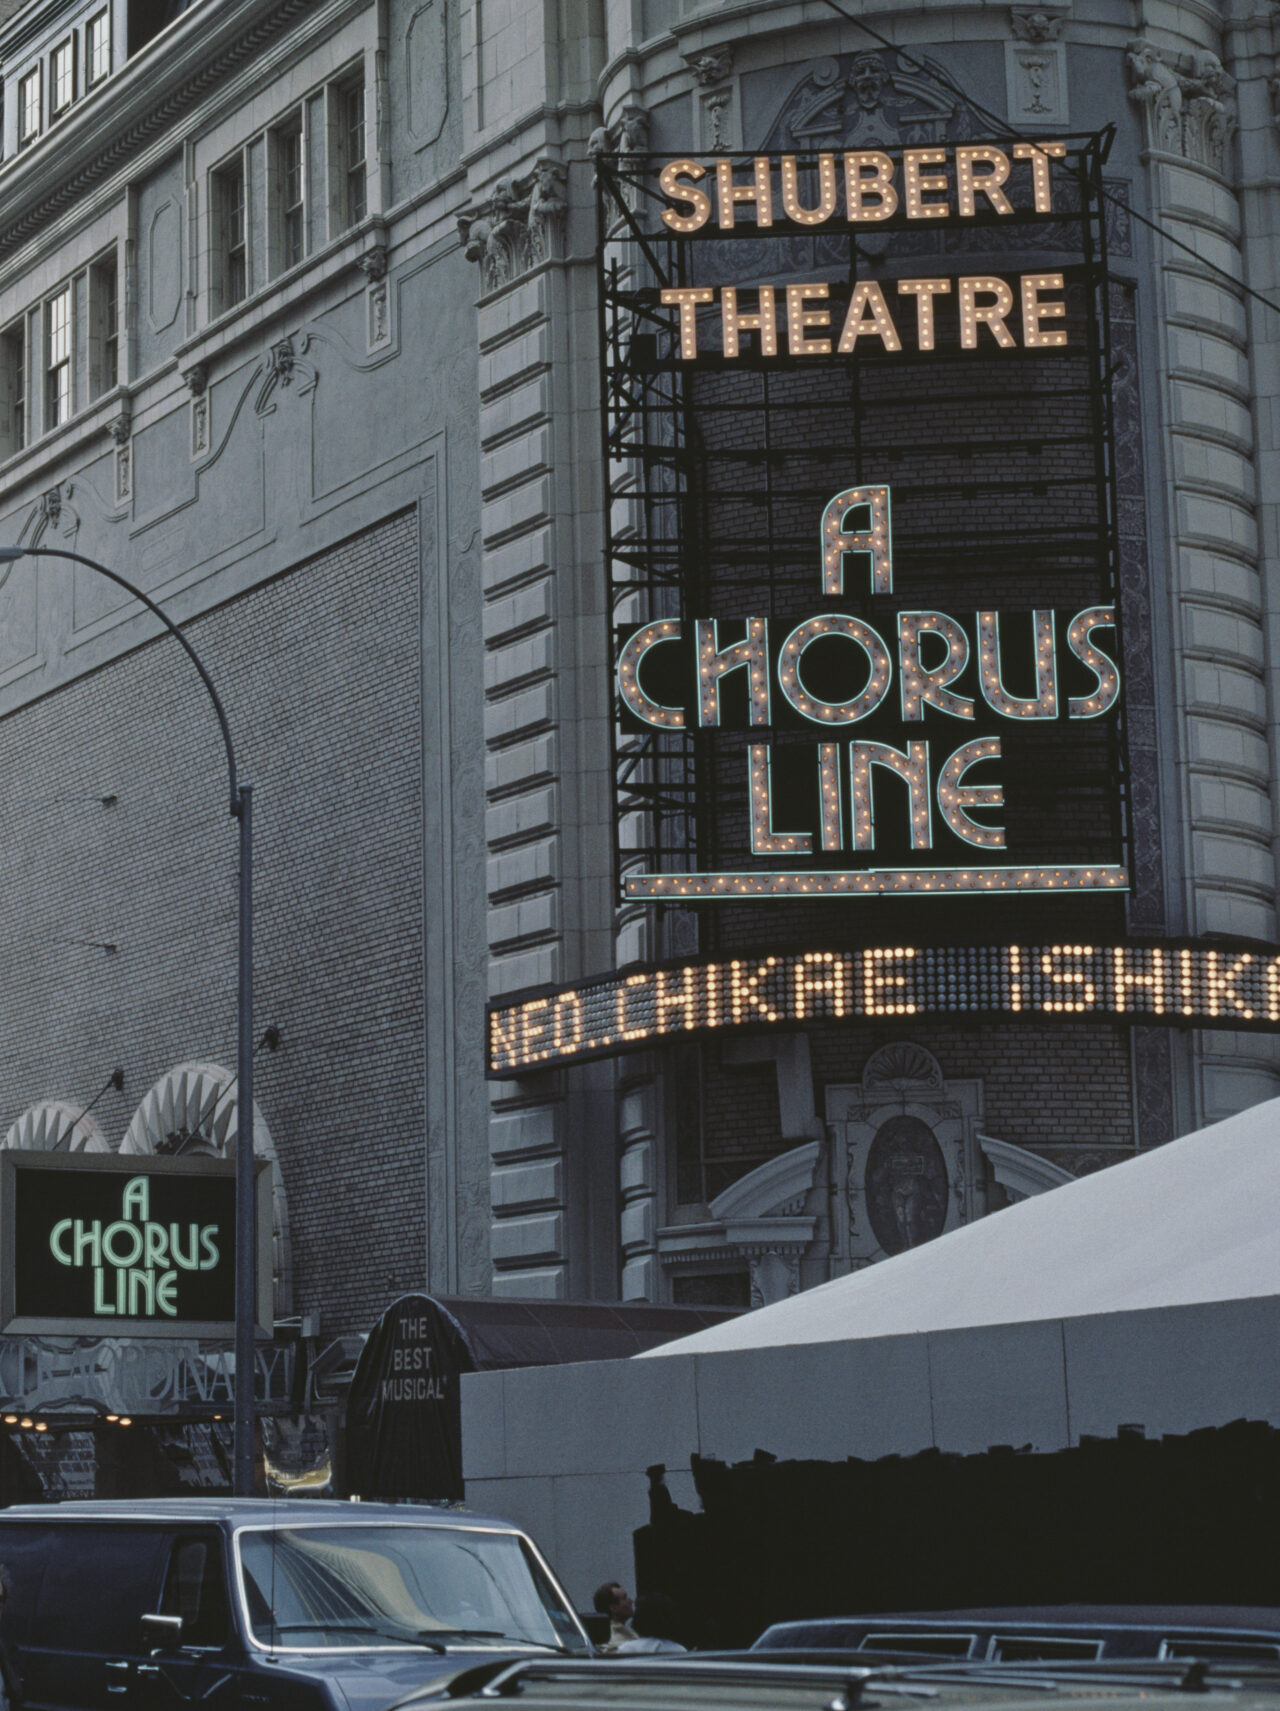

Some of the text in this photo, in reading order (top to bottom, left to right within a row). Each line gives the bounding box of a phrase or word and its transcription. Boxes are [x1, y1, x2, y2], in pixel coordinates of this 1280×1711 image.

[659, 142, 1067, 233] SHUBERT
[661, 273, 1069, 361] THEATRE
[820, 485, 893, 595] A
[619, 606, 1121, 729] CHORUS
[748, 736, 1008, 855] LINE
[123, 1175, 149, 1221] A
[49, 1217, 220, 1270] CHORUS
[94, 1267, 178, 1316] LINE
[393, 1347, 432, 1371] BEST
[400, 1317, 428, 1340] THE
